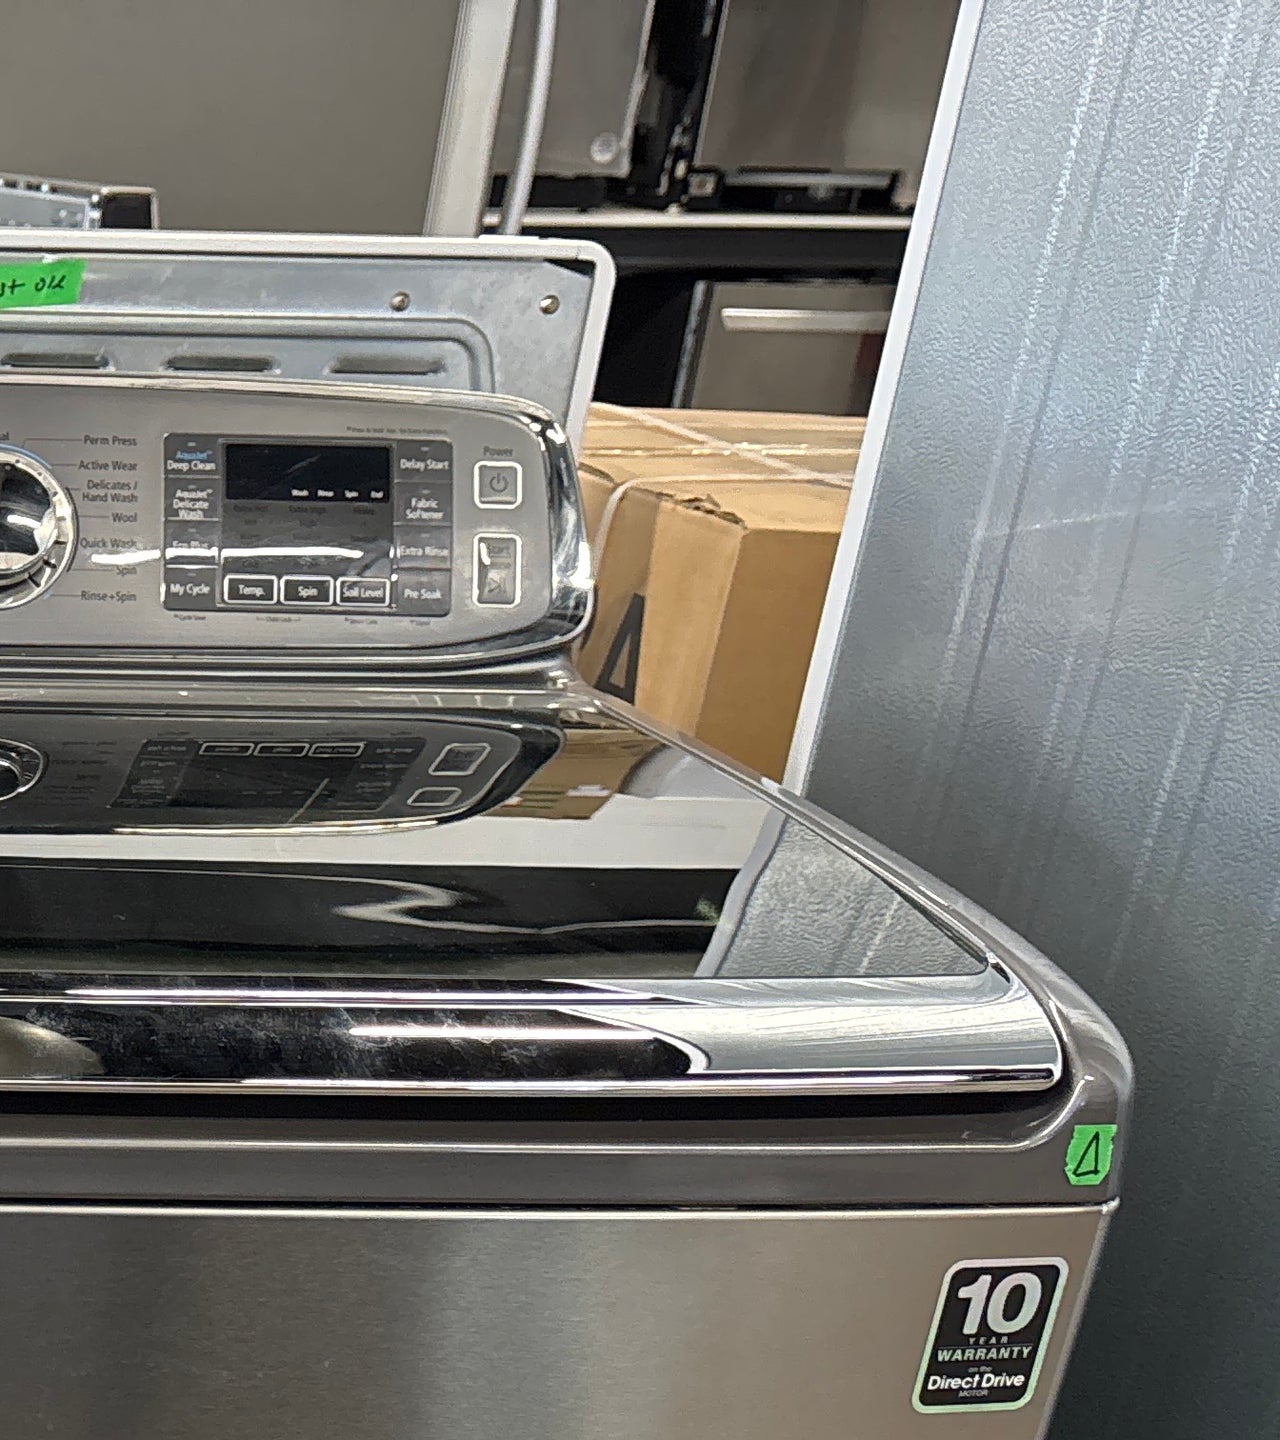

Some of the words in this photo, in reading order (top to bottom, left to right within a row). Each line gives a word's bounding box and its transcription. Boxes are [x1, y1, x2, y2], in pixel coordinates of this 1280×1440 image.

[83, 435, 106, 445] Perm
[112, 435, 137, 446] Press
[483, 446, 514, 456] Power
[78, 461, 106, 470] Active
[111, 461, 137, 471] Wear
[167, 461, 189, 471] Deep
[191, 461, 216, 470] Clean
[400, 459, 424, 472] Delay
[427, 459, 449, 470] Start
[87, 480, 130, 490] Delicates
[82, 493, 106, 502] Hand
[109, 493, 138, 502] Wash
[411, 498, 438, 508] Fabric
[112, 512, 137, 522] Wool
[80, 538, 106, 548] Quick
[109, 538, 136, 548] Wash
[170, 583, 184, 596] My
[186, 583, 210, 596] Cycle
[238, 584, 266, 598] Temp.
[298, 586, 318, 598] Spin
[342, 587, 358, 598] Soil
[361, 588, 384, 598] Level
[958, 1272, 1042, 1334] 10
[969, 1336, 1008, 1345] YEAR
[937, 1347, 1032, 1362] WARRANTY
[927, 1373, 980, 1390] Direct
[981, 1373, 1024, 1388] Drive
[958, 1389, 988, 1398] MOTOR
